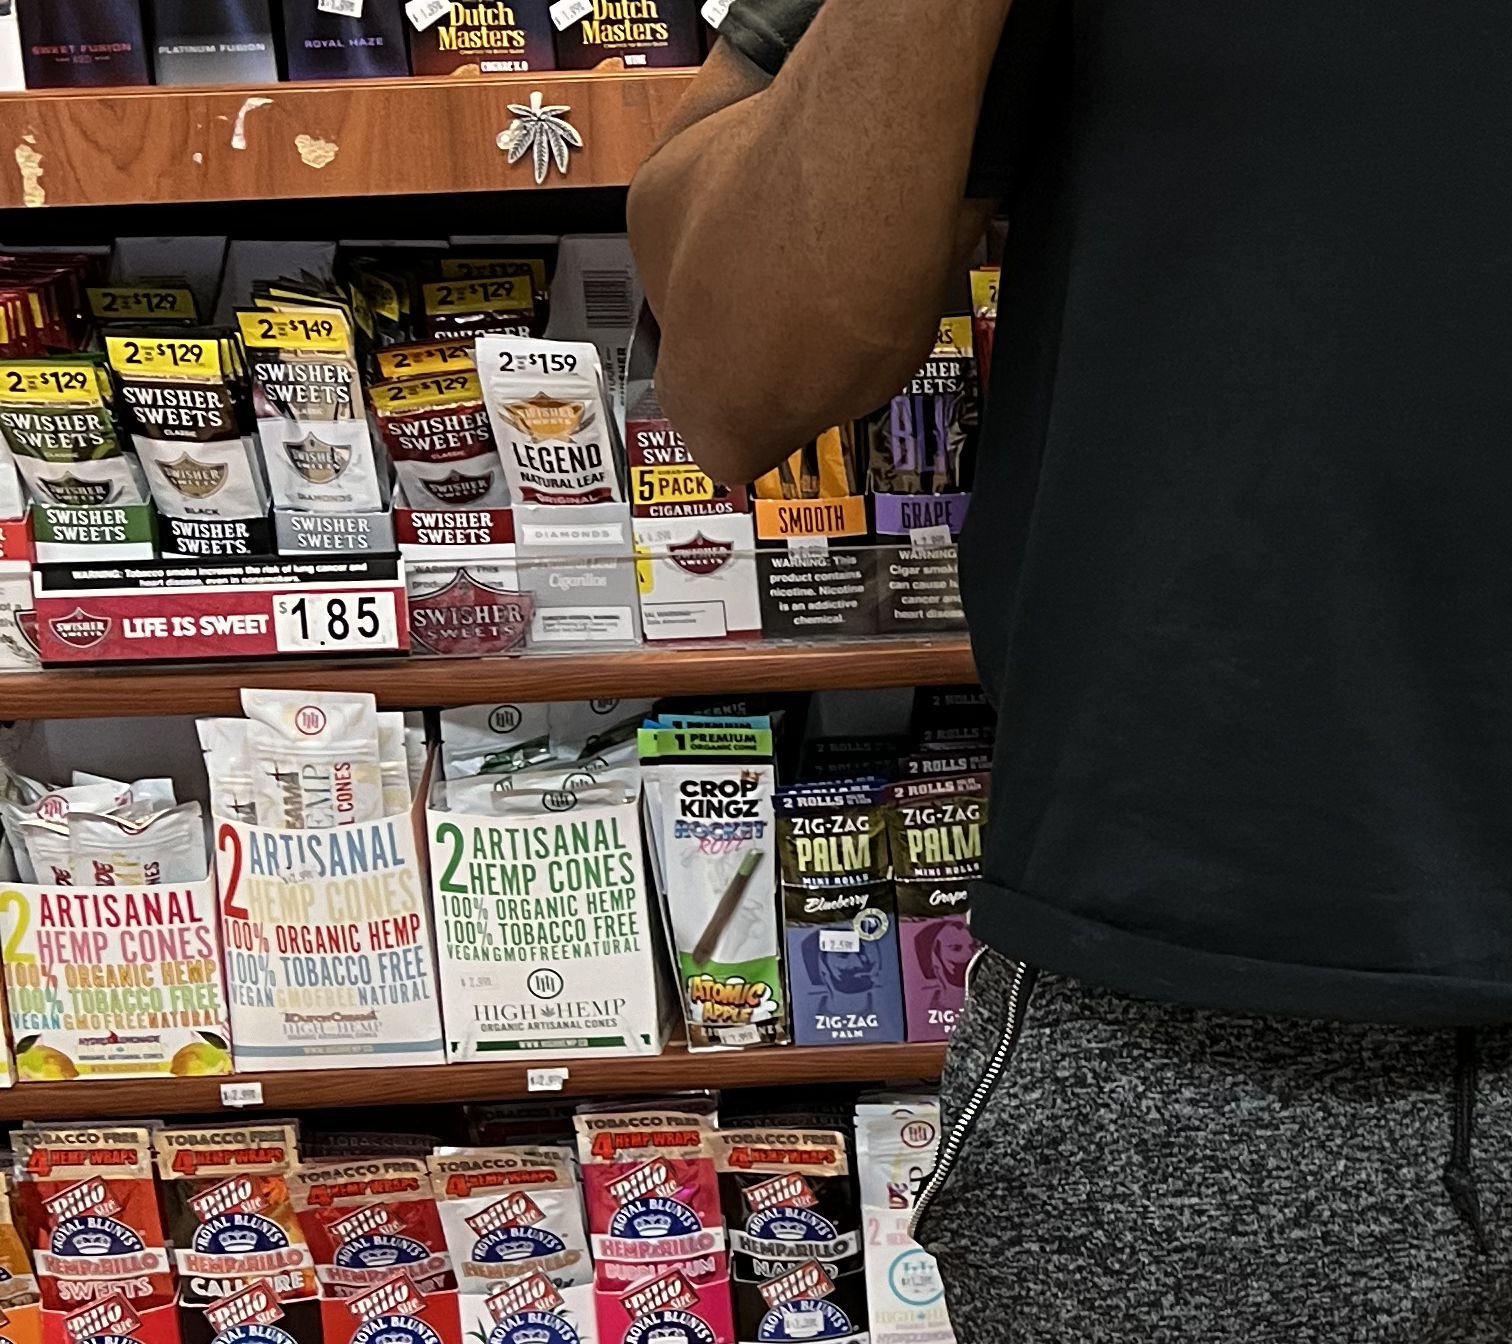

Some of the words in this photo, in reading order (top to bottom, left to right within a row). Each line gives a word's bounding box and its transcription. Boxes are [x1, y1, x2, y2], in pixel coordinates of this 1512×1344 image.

[123, 387, 224, 408] SWISHER
[133, 407, 223, 427] SWEETS
[513, 443, 602, 474] LEGEND
[520, 472, 576, 488] NATURAL
[579, 471, 605, 486] LEAF
[638, 470, 654, 502] 5
[659, 472, 708, 495] PACK
[411, 512, 494, 528] SWISHER
[649, 502, 733, 516] CIGARILLOS
[779, 505, 844, 533] SMOOTH
[417, 528, 491, 543] SWEETS
[123, 617, 169, 638] LIFE
[173, 617, 195, 635] IS
[199, 614, 270, 635] SWEET
[679, 778, 759, 799] CROP
[679, 798, 760, 819] KINGZ
[473, 817, 626, 860] ARTISANAL
[467, 864, 538, 895] HEMP
[549, 853, 636, 892] CONES
[36, 932, 108, 963] HEMP
[120, 926, 213, 962] CONES
[276, 925, 360, 954] ORGANIC
[370, 914, 421, 950] HEMP
[473, 1003, 537, 1021] HIGH
[557, 999, 627, 1018] HEMP
